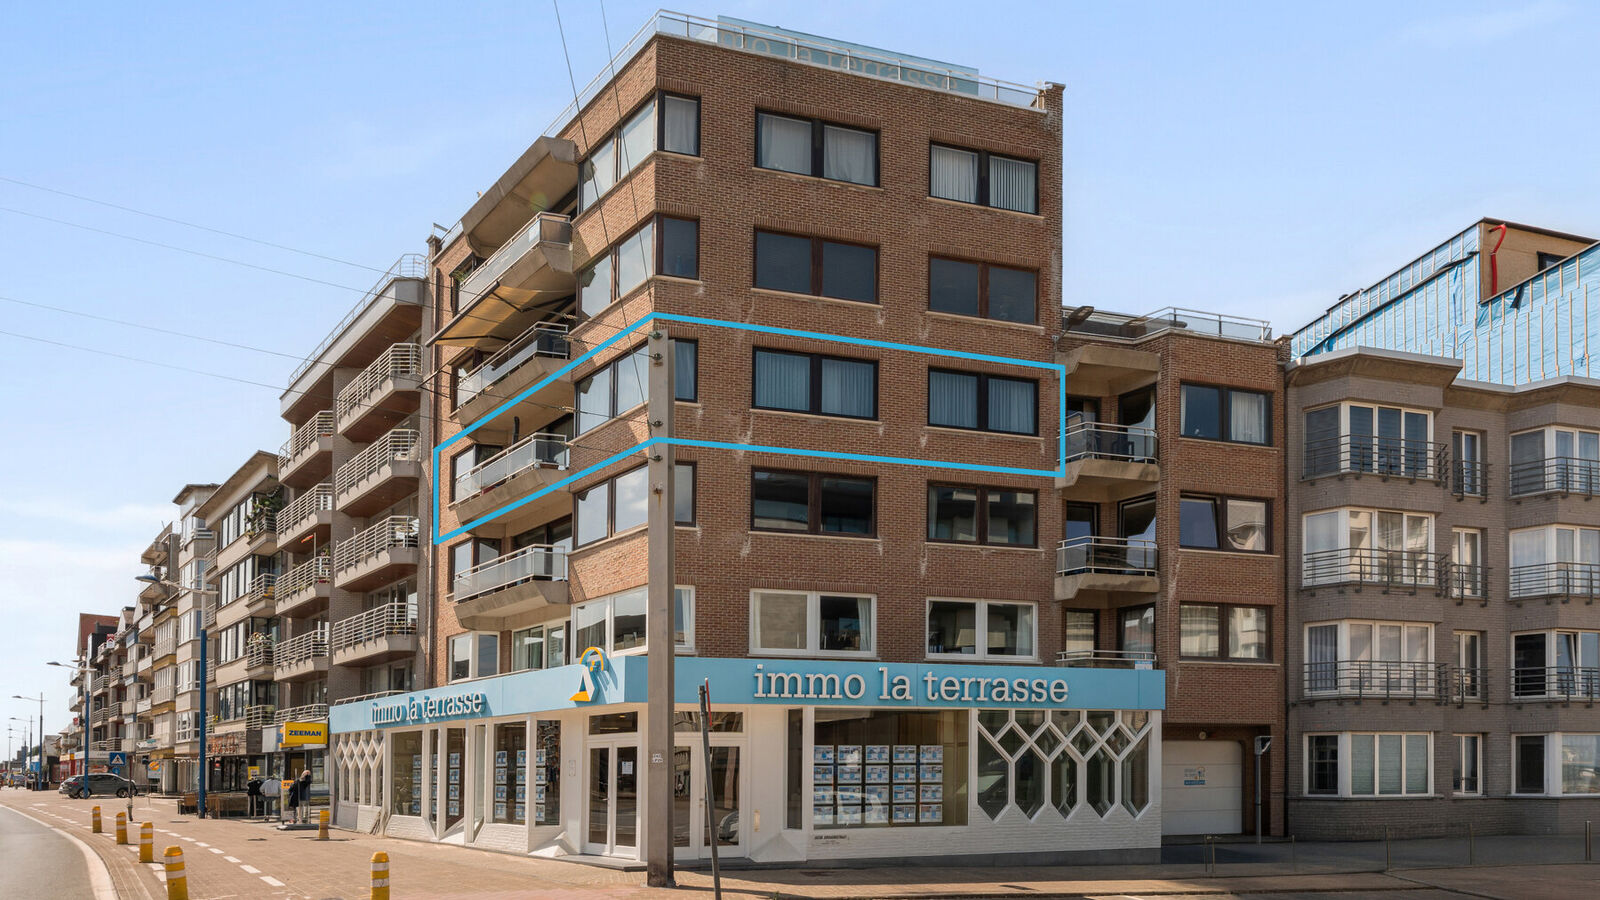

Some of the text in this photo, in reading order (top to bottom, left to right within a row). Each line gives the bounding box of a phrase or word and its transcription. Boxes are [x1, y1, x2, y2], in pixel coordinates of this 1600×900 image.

[754, 664, 1069, 703] immo la terrasse
[371, 692, 483, 724] immo la terrasse
[288, 729, 322, 737] ZEEMAN
